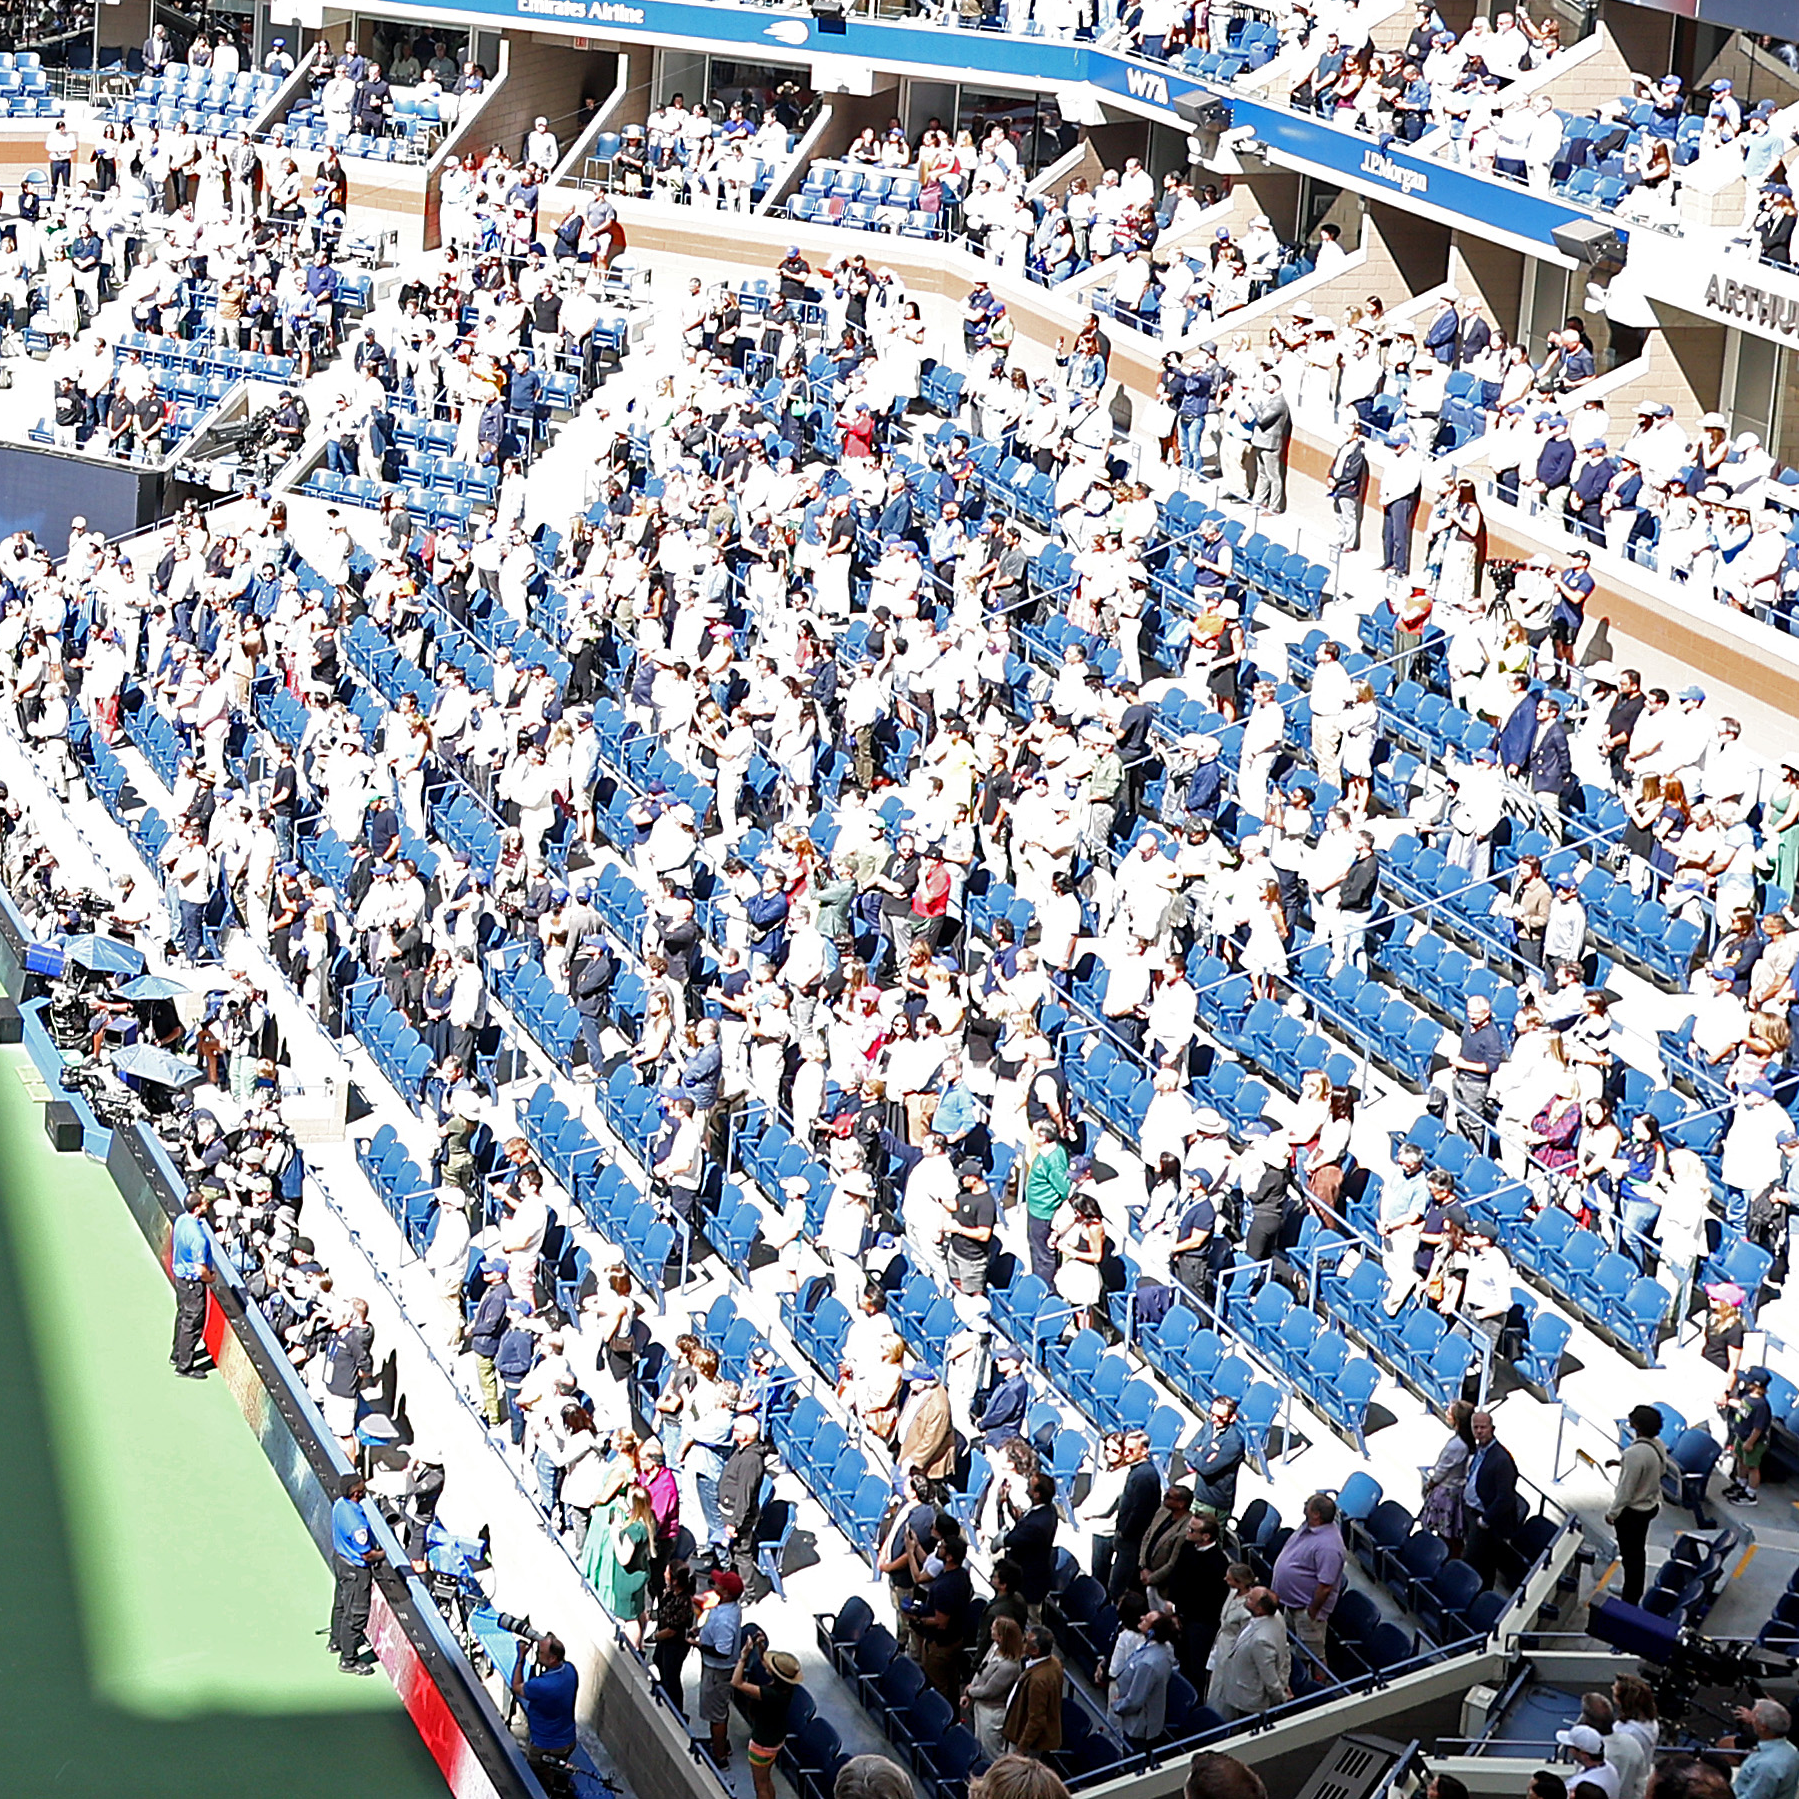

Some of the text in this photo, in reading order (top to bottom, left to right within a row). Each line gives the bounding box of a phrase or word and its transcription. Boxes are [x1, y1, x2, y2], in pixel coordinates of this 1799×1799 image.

[588, 1, 645, 25] Airline
[1126, 66, 1170, 106] WTA
[1704, 272, 1799, 337] ARTHU
